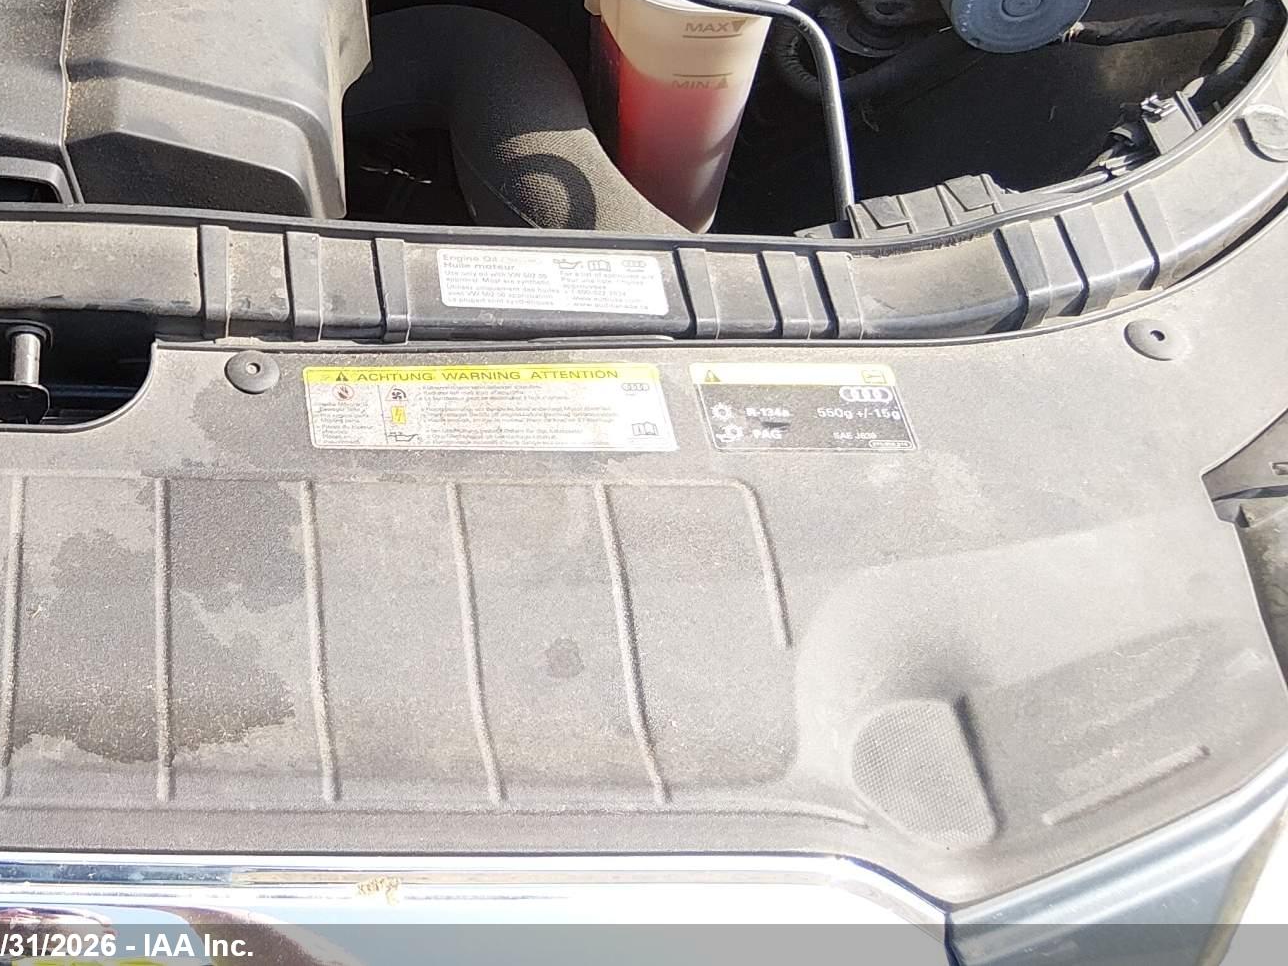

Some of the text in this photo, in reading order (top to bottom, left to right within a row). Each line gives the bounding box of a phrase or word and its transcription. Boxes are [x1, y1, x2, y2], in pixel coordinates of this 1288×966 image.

[685, 22, 730, 33] MAX
[671, 80, 710, 91] MIN
[443, 254, 480, 264] Engine
[356, 369, 618, 382] ACHTUNG WARNING ATTENTION
[816, 407, 853, 420] 550g
[752, 429, 783, 440] PAG
